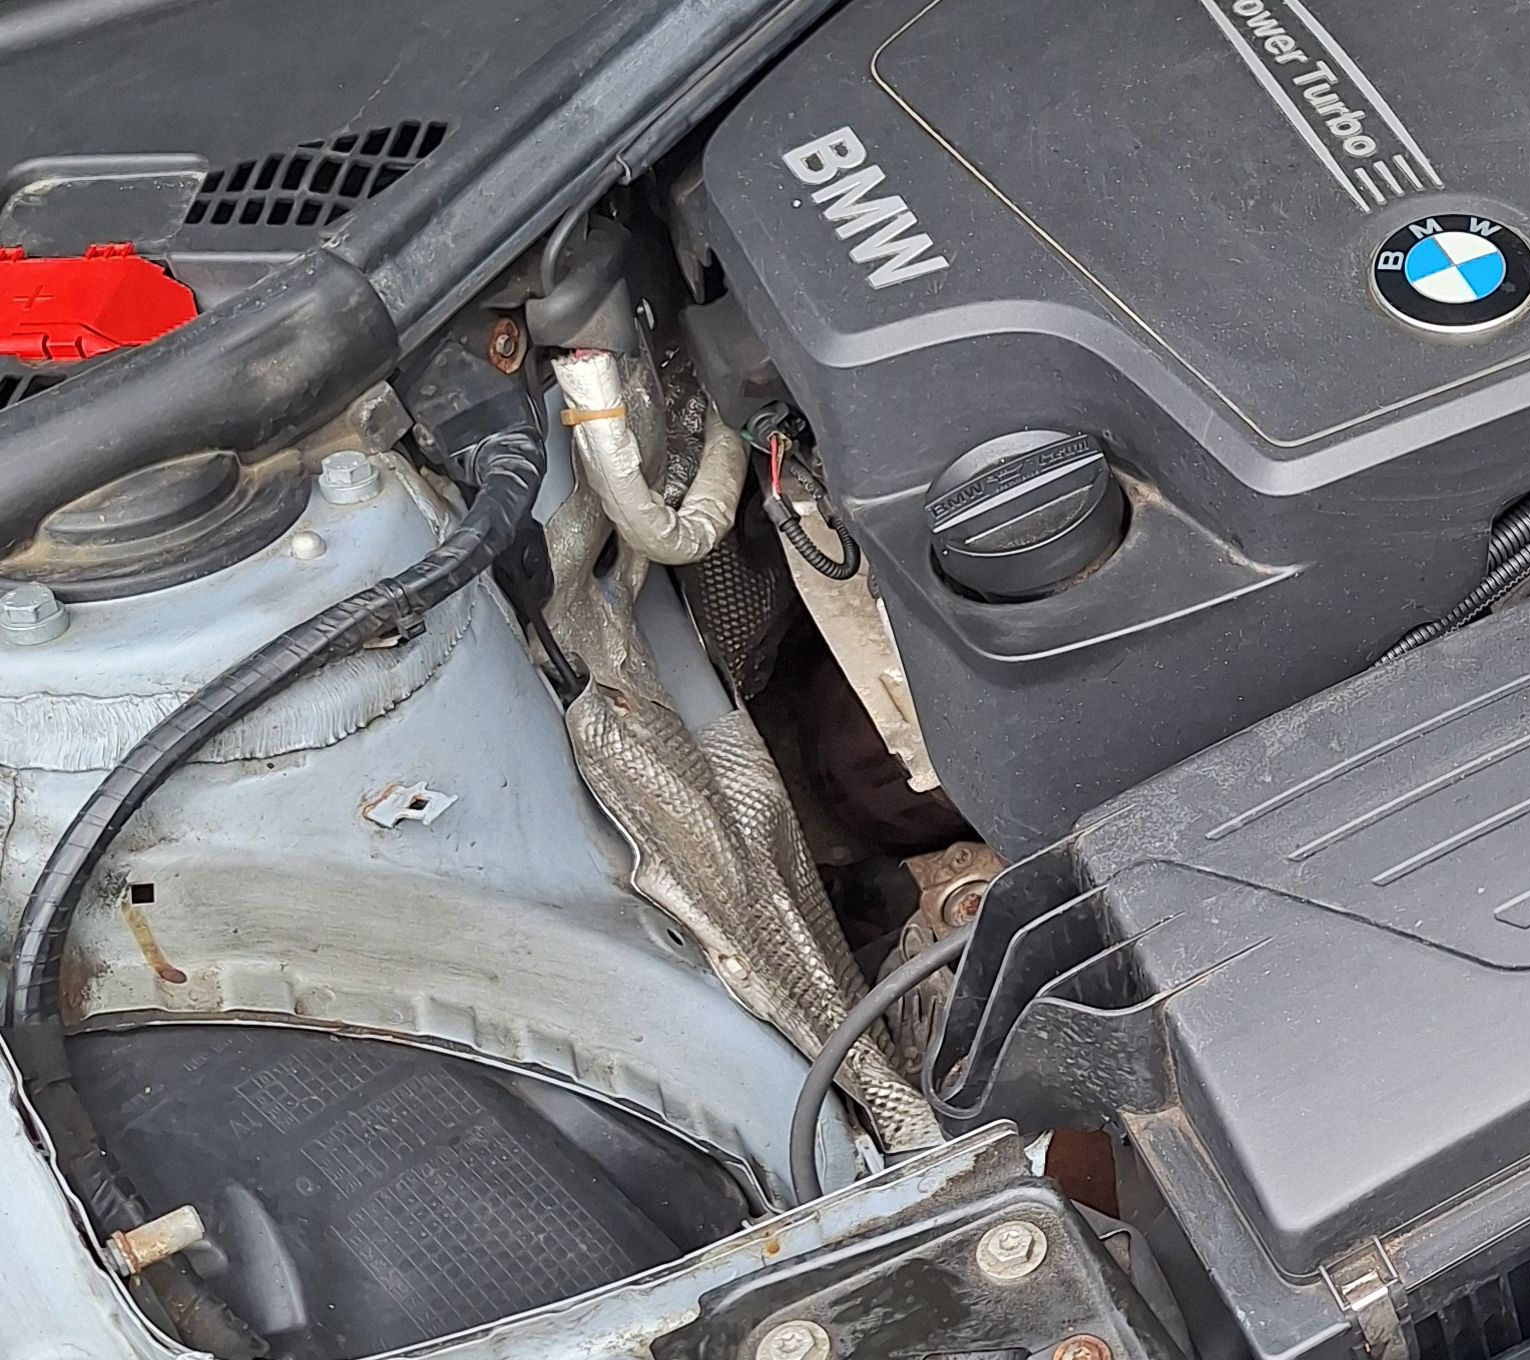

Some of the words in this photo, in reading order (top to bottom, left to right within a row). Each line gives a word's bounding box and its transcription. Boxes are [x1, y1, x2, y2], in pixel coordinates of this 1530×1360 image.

[1292, 60, 1377, 158] Turbo
[782, 125, 950, 290] BMW
[1377, 217, 1502, 271] BMW
[930, 482, 985, 520] BMW
